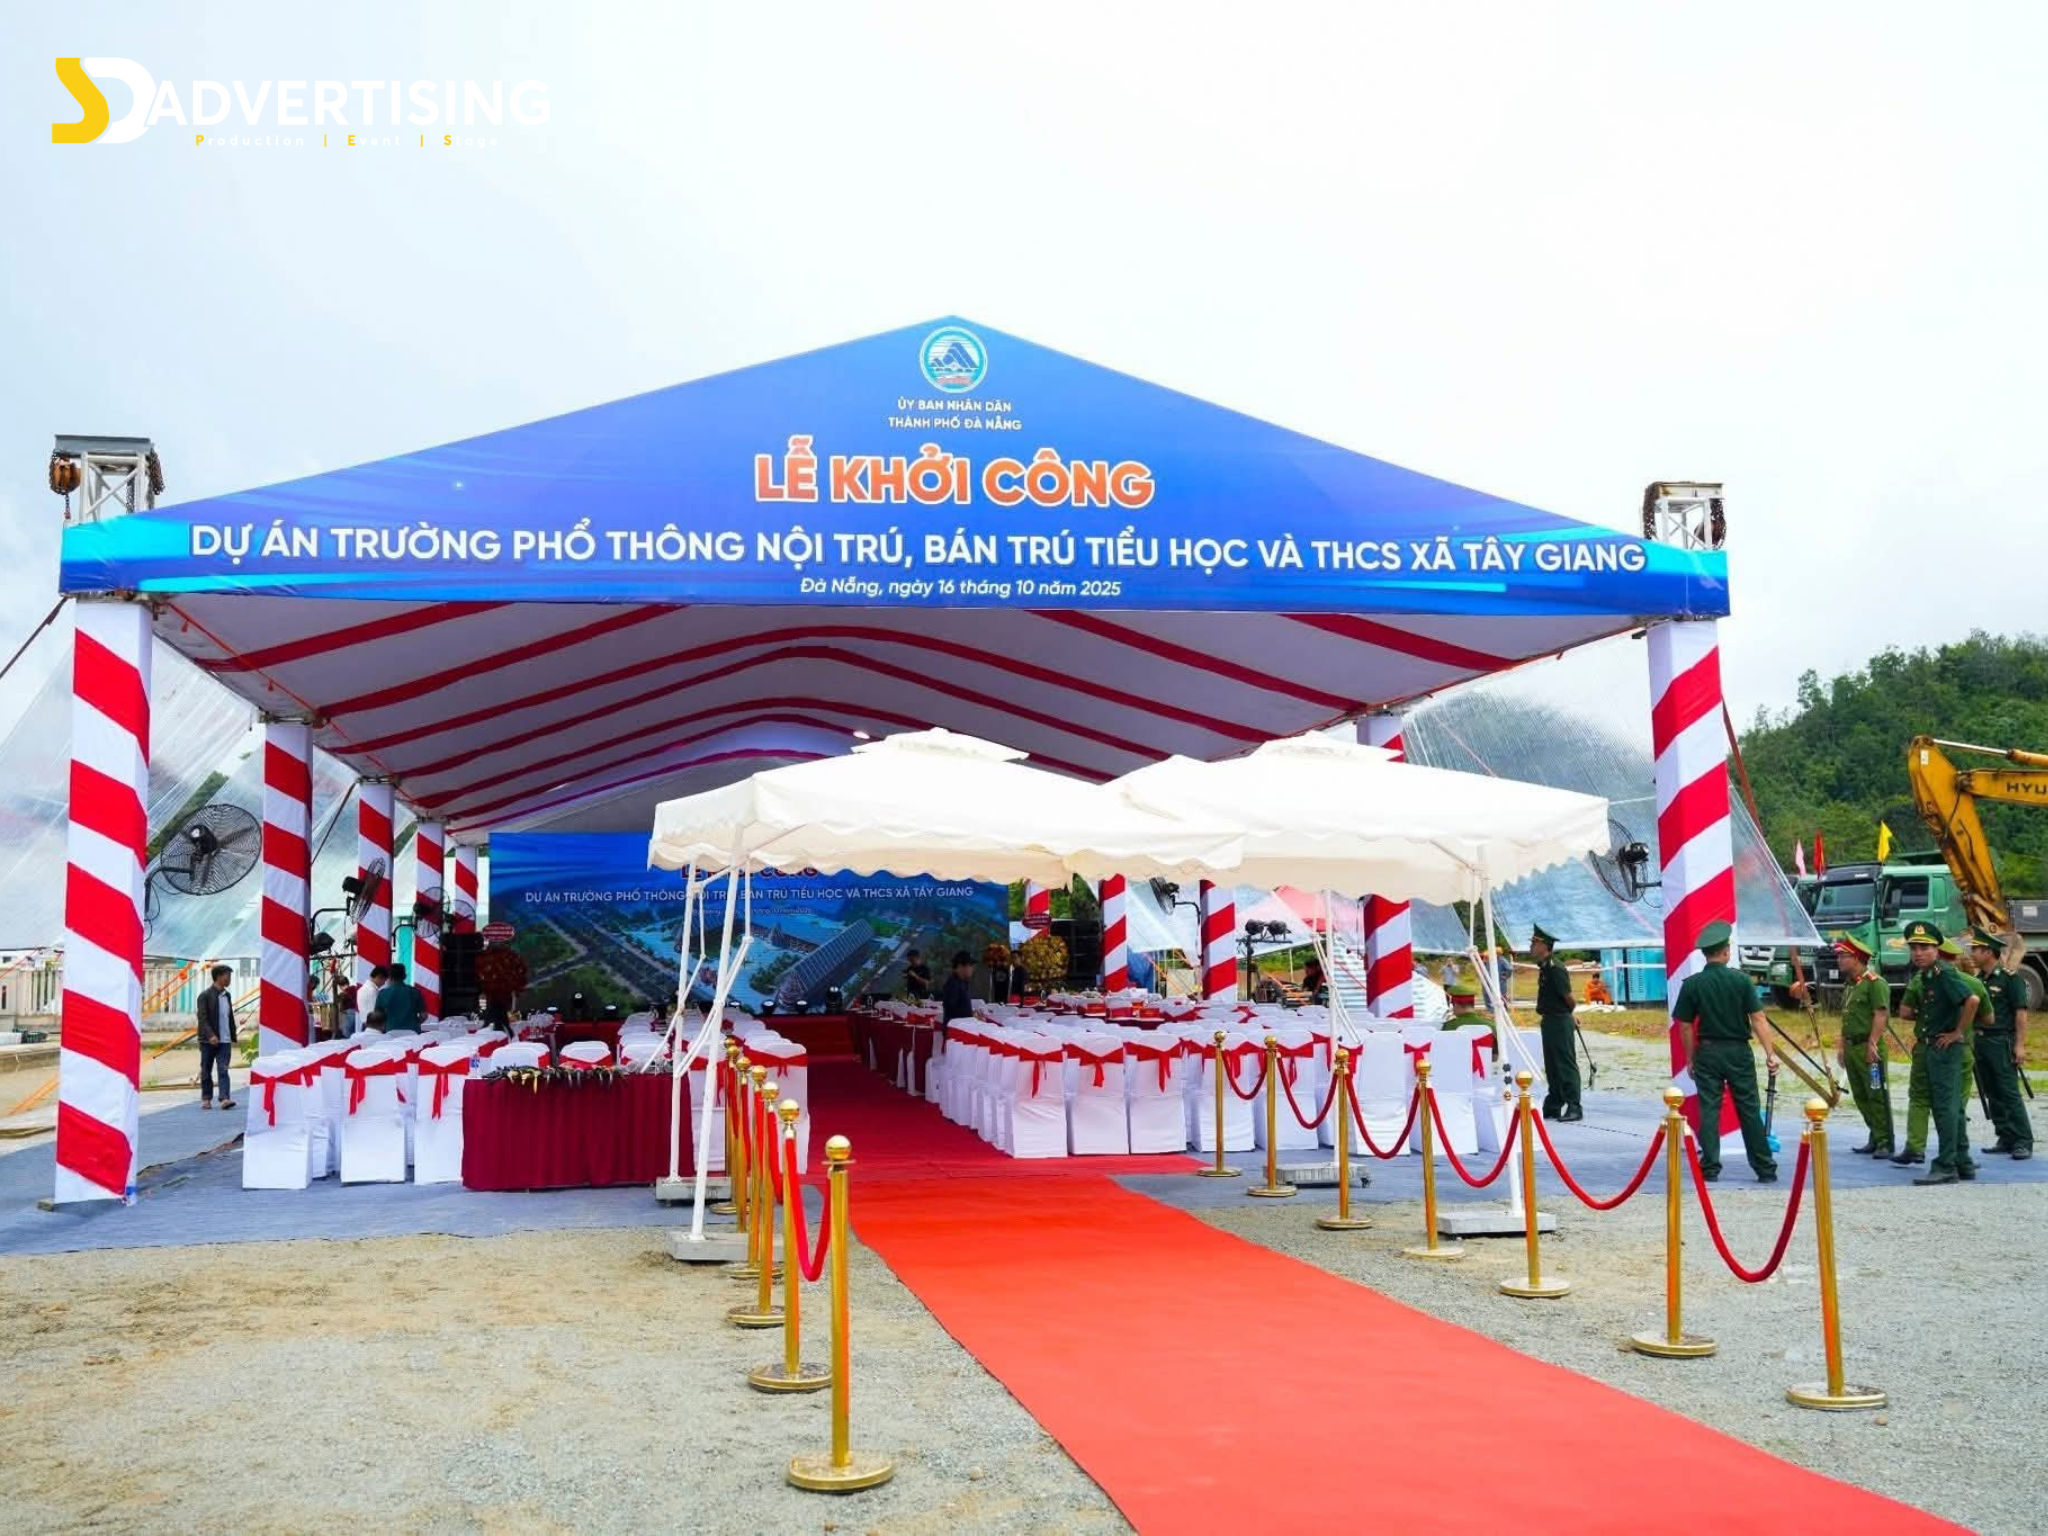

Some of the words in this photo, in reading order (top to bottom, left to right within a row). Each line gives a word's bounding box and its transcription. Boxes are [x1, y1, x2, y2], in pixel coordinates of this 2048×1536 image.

[918, 399, 944, 411] BAN
[947, 398, 981, 411] NHÂN
[985, 400, 1012, 412] DÂN
[888, 415, 931, 428] THÀNH
[933, 414, 960, 429] PHỐ
[964, 416, 982, 430] ĐÀ
[755, 434, 818, 503] LỄ
[829, 442, 972, 505] KHỞI
[981, 447, 1156, 509] CÔNG
[192, 523, 253, 565] DỰ
[260, 519, 318, 558] ÁN
[330, 521, 501, 560] TRƯỜNG
[513, 517, 596, 560] PHỔ
[606, 523, 745, 561] THÔNG
[757, 525, 823, 570] NỘI
[833, 526, 912, 568] TRÚ,
[925, 527, 997, 564] BÁN
[1007, 529, 1075, 565] TRÚ
[1085, 525, 1158, 566] TIỂU
[1170, 538, 1248, 575] HỌC
[1257, 533, 1303, 568] VÀ
[1311, 540, 1401, 570] THCS
[1410, 536, 1456, 570] XÃ
[1463, 536, 1524, 571] TÂY
[1535, 542, 1646, 571] GIANG
[800, 577, 827, 594] Đà
[831, 576, 884, 598] Nẵng,
[888, 580, 933, 598] ngày
[938, 580, 955, 594] 16
[959, 579, 1011, 598] tháng
[1016, 580, 1035, 595] 10
[1038, 580, 1077, 596] năm
[1079, 581, 1122, 596] 2025
[863, 887, 893, 899] THCS
[936, 886, 974, 897] GIANG
